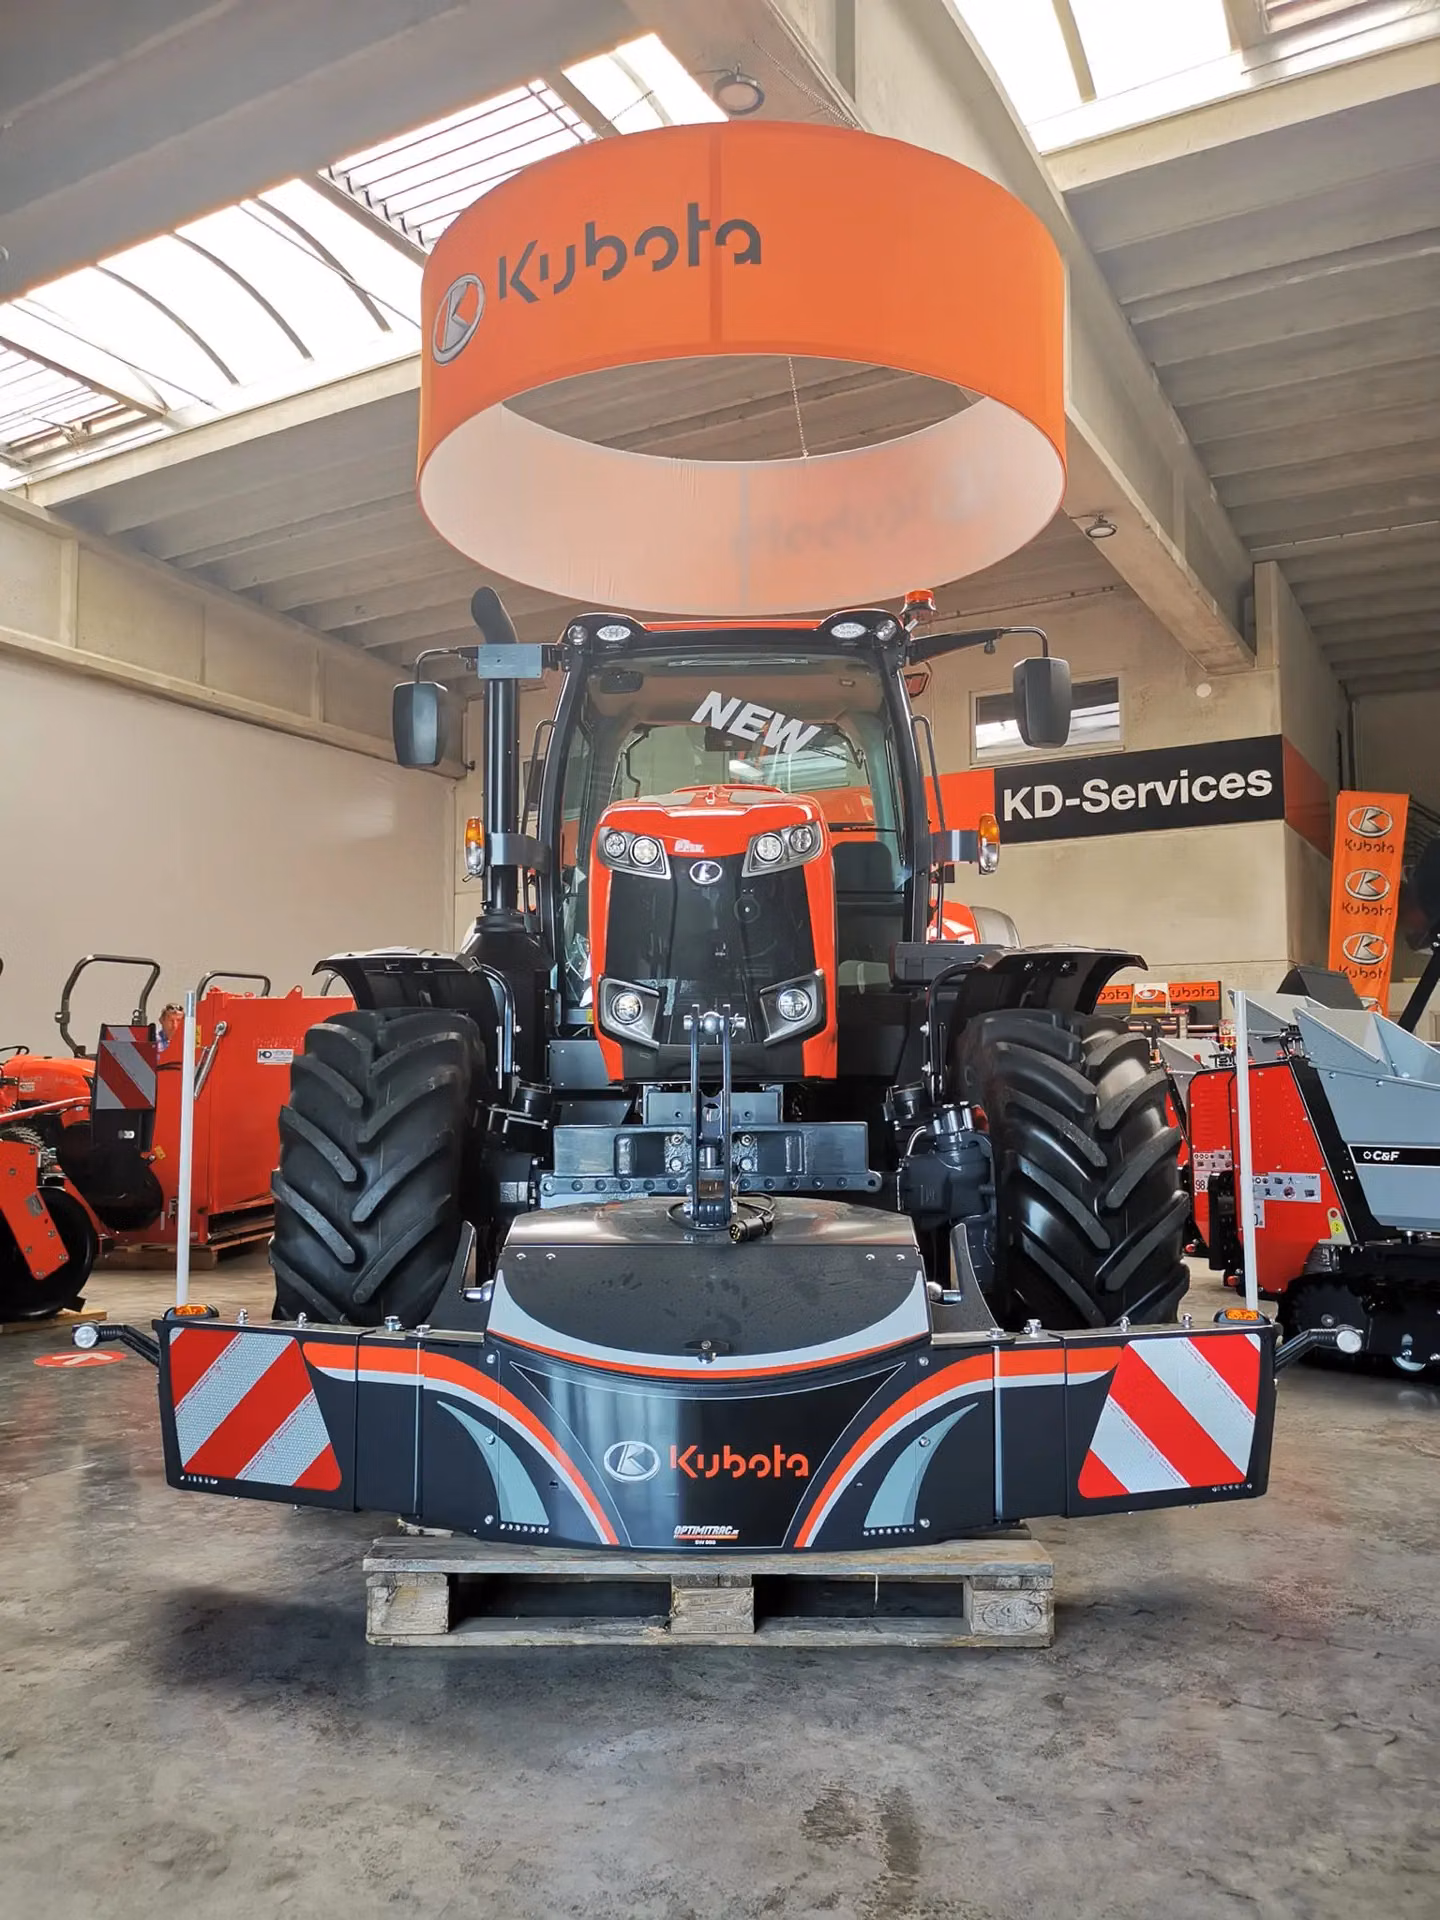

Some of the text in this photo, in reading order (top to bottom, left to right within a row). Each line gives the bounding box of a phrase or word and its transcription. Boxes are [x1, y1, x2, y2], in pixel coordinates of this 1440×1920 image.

[498, 202, 762, 304] Kubota
[691, 691, 822, 753] NEW
[1003, 769, 1273, 822] KD-Services
[1344, 838, 1395, 853] Kubota
[1372, 1150, 1400, 1161] C&F
[669, 1444, 810, 1478] Kubota
